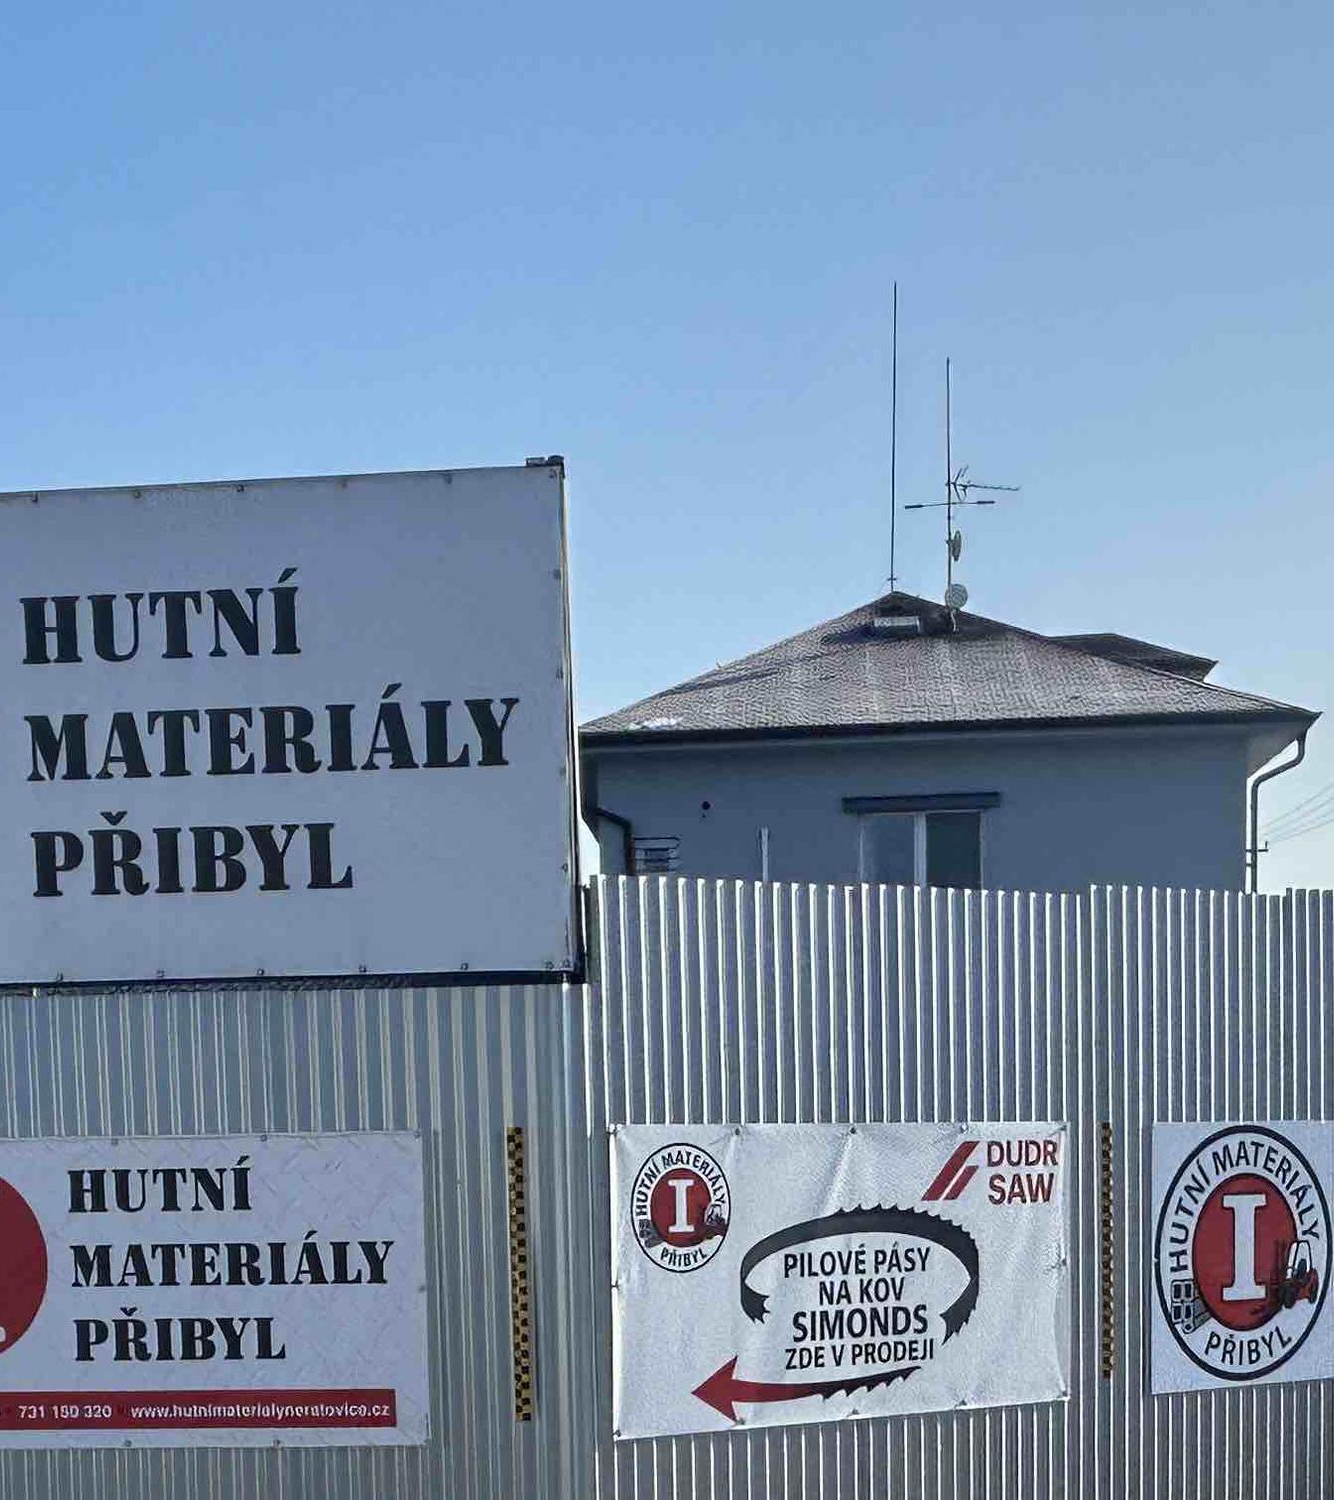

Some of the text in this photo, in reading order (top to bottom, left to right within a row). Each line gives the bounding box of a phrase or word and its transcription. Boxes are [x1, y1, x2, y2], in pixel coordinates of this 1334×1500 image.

[20, 567, 302, 664] HUTNÍ
[24, 683, 519, 782] MATERIÁLY
[30, 811, 353, 897] PŘIBYL
[987, 1140, 1058, 1167] DUDR
[68, 1155, 252, 1213] HUTNÍ
[635, 1158, 661, 1217] HUTNÍ
[988, 1172, 1054, 1205] SAW
[1169, 1141, 1320, 1272] HUTNÍ MATERIÁLY
[70, 1230, 394, 1287] MATERIÁLY
[784, 1241, 931, 1278] PILOVÉ PÁSY
[819, 1277, 905, 1306] NA KOV
[74, 1306, 286, 1361] PŘIBYL
[792, 1304, 928, 1343] SIMONDS
[1205, 1326, 1292, 1366] PŘIBYL
[785, 1338, 935, 1370] ZDE V PRODEJI
[18, 1405, 45, 1418] 731
[83, 1405, 112, 1418] 320
